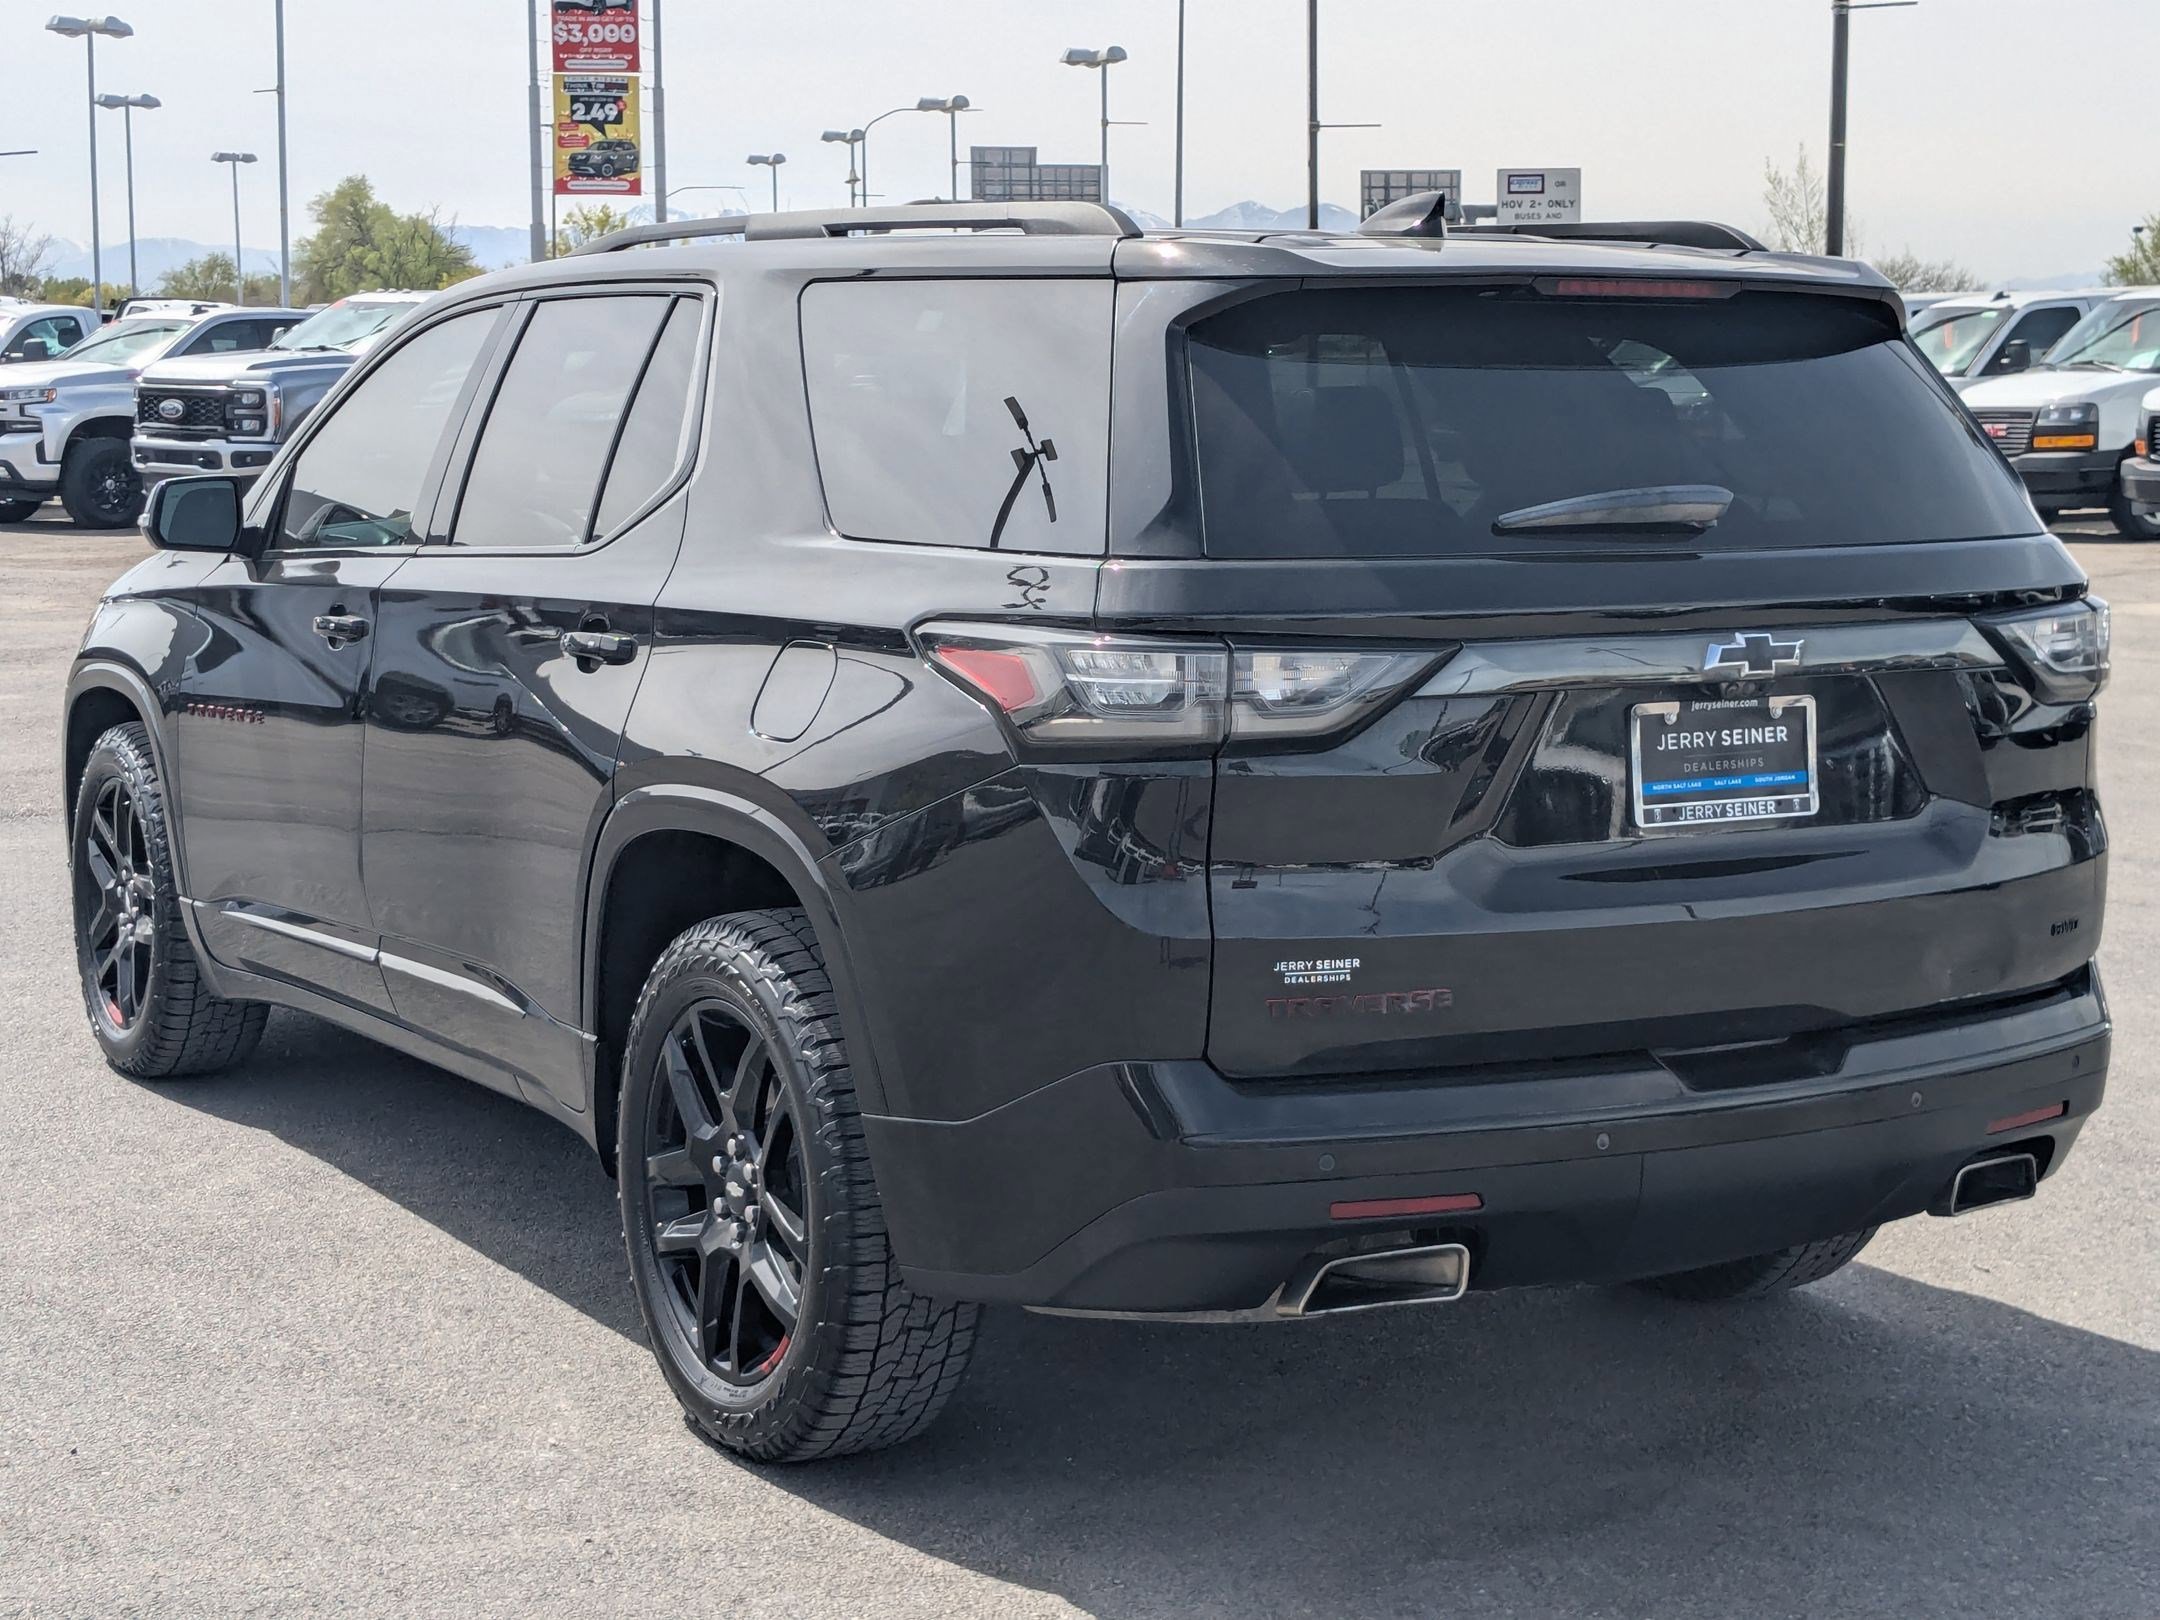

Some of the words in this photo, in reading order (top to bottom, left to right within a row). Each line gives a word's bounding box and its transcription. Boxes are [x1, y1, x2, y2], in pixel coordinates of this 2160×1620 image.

[553, 21, 636, 46] $3,000
[1501, 199, 1523, 208] HOV
[1547, 199, 1576, 208] ONLY
[1514, 212, 1541, 220] BUSES
[1691, 699, 1758, 712] jerryseiner.com
[1657, 730, 1717, 751] JERRY
[1721, 725, 1788, 746] SEINER
[1684, 757, 1764, 773] DEALERSHIPS
[1679, 804, 1722, 821] JERRY
[1726, 801, 1776, 817] SEINER
[1273, 960, 1314, 971] JERRY
[1316, 958, 1360, 970] SEINER
[1284, 973, 1351, 984] DEALERSHIPS
